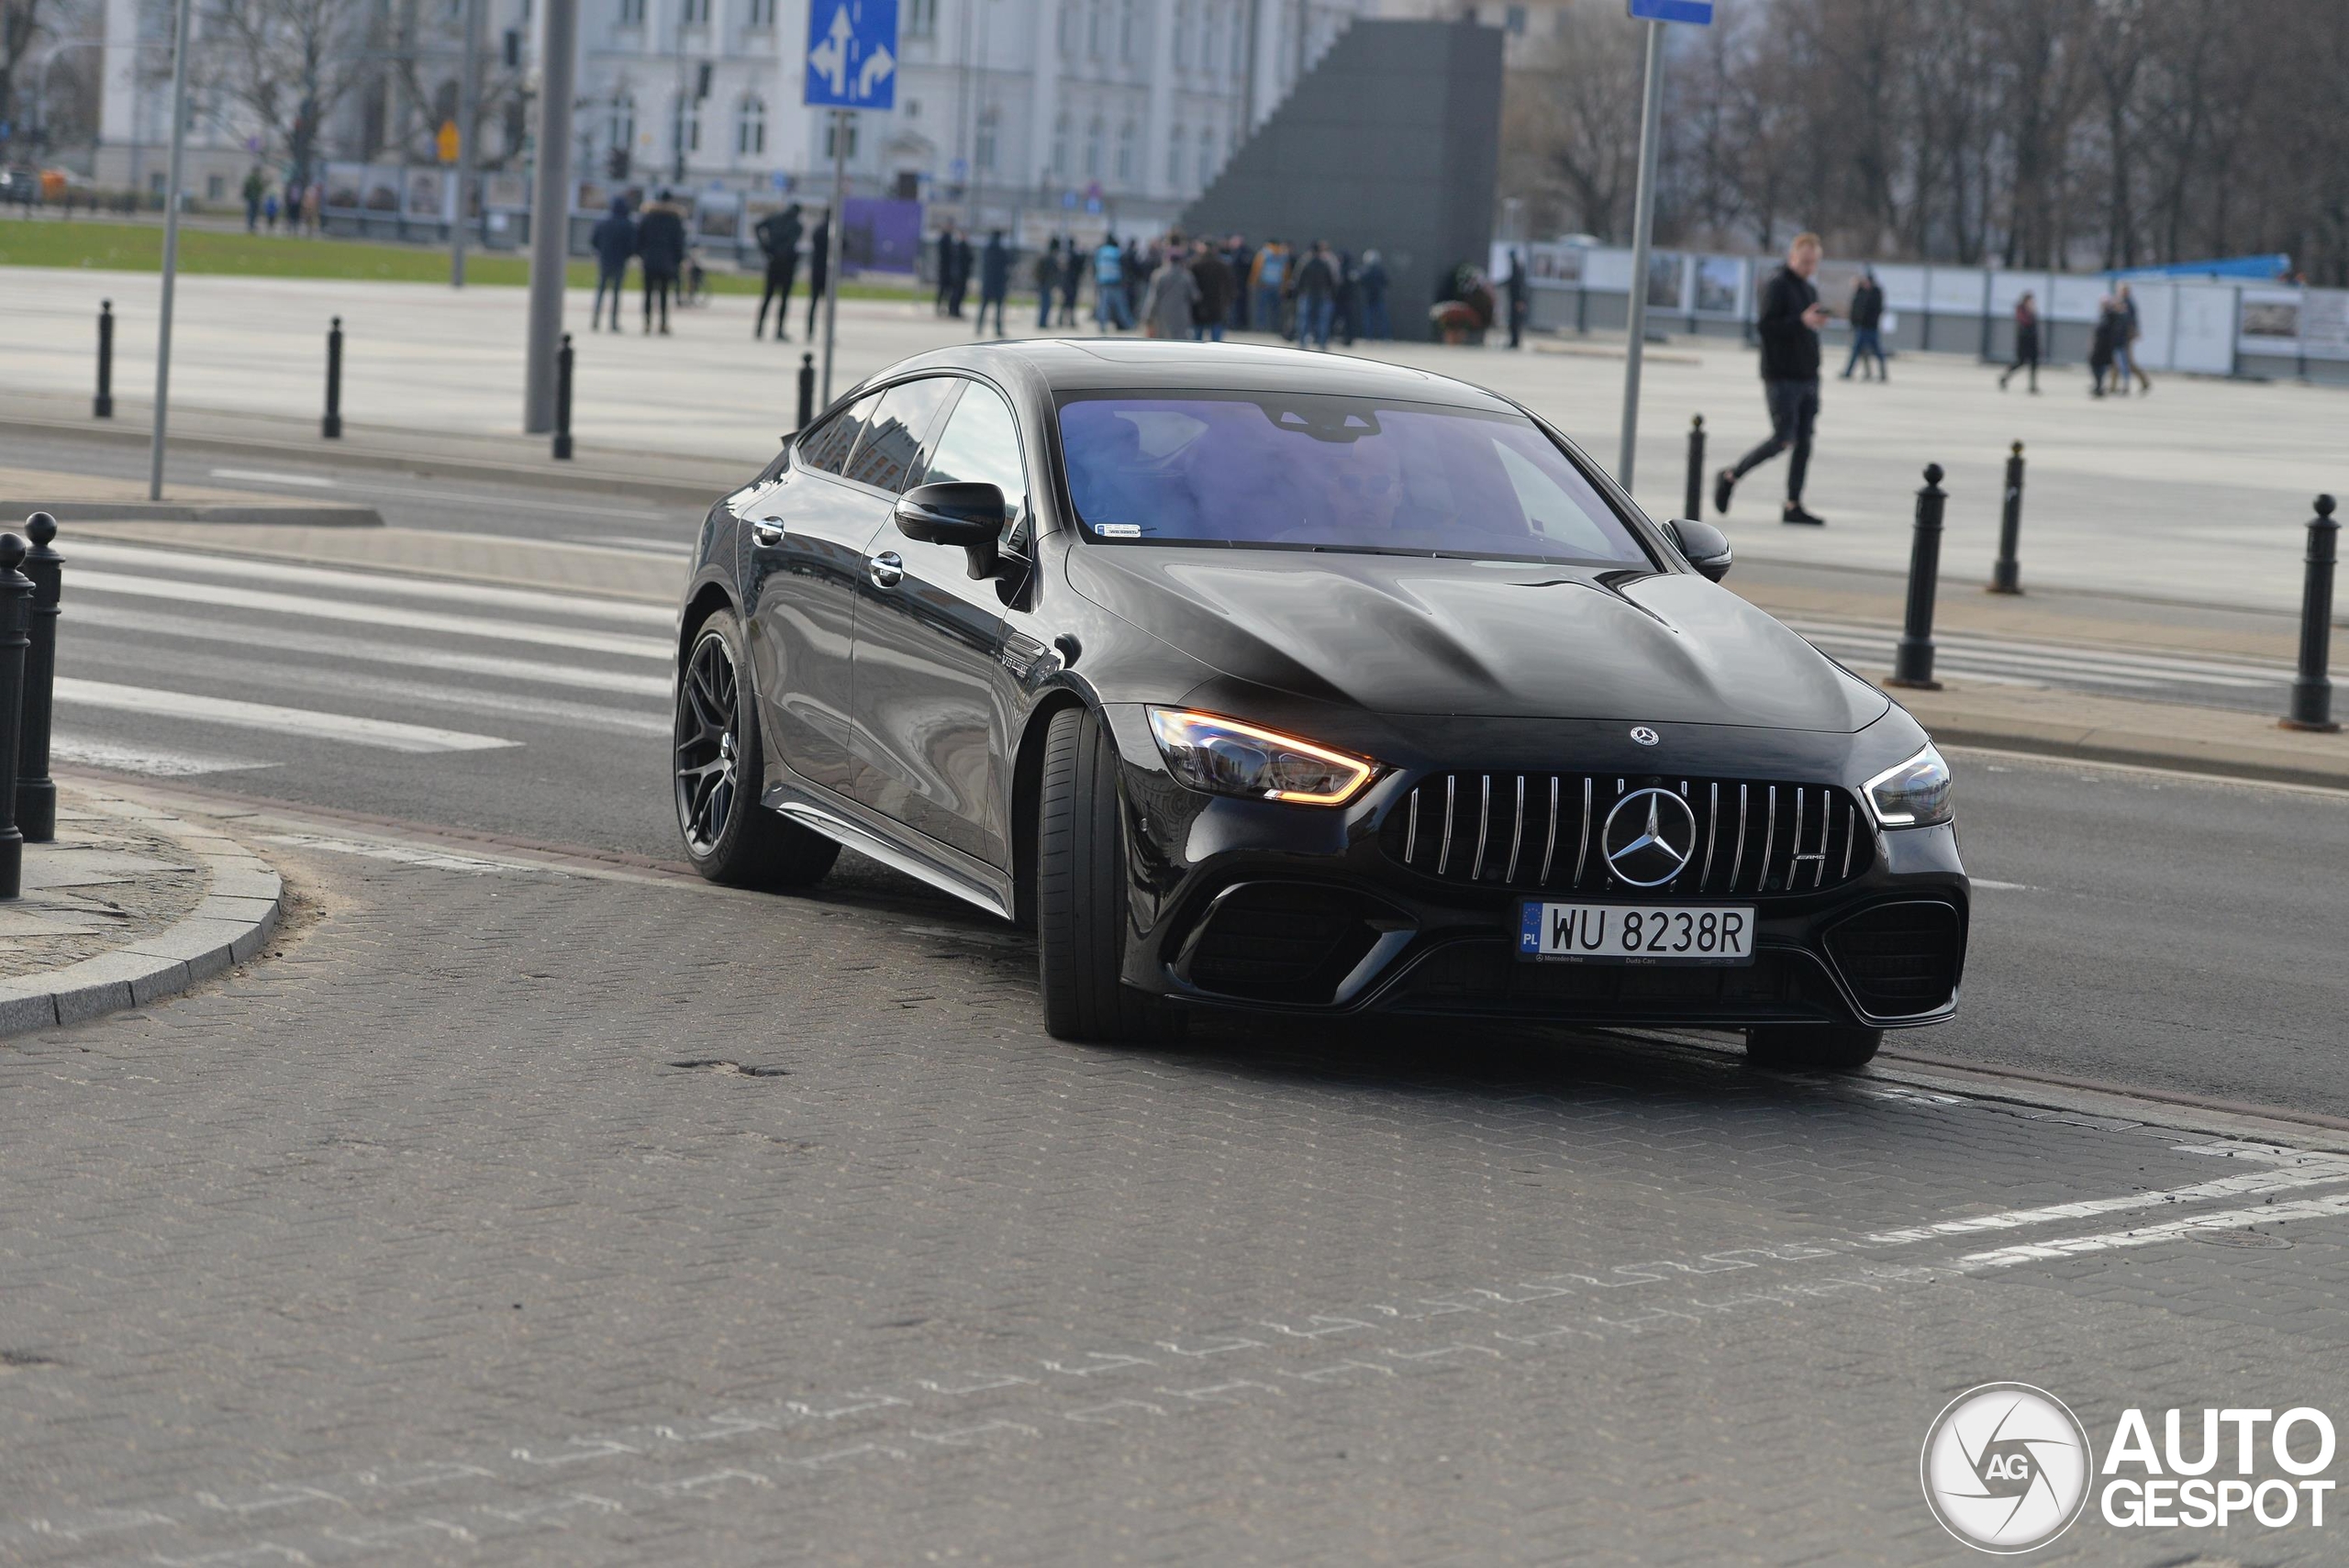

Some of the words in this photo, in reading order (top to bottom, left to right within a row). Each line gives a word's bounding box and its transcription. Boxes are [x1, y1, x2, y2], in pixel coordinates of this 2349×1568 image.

[1523, 933, 1538, 945] PL
[1553, 908, 1606, 950] WU
[1621, 911, 1743, 952] 8238R
